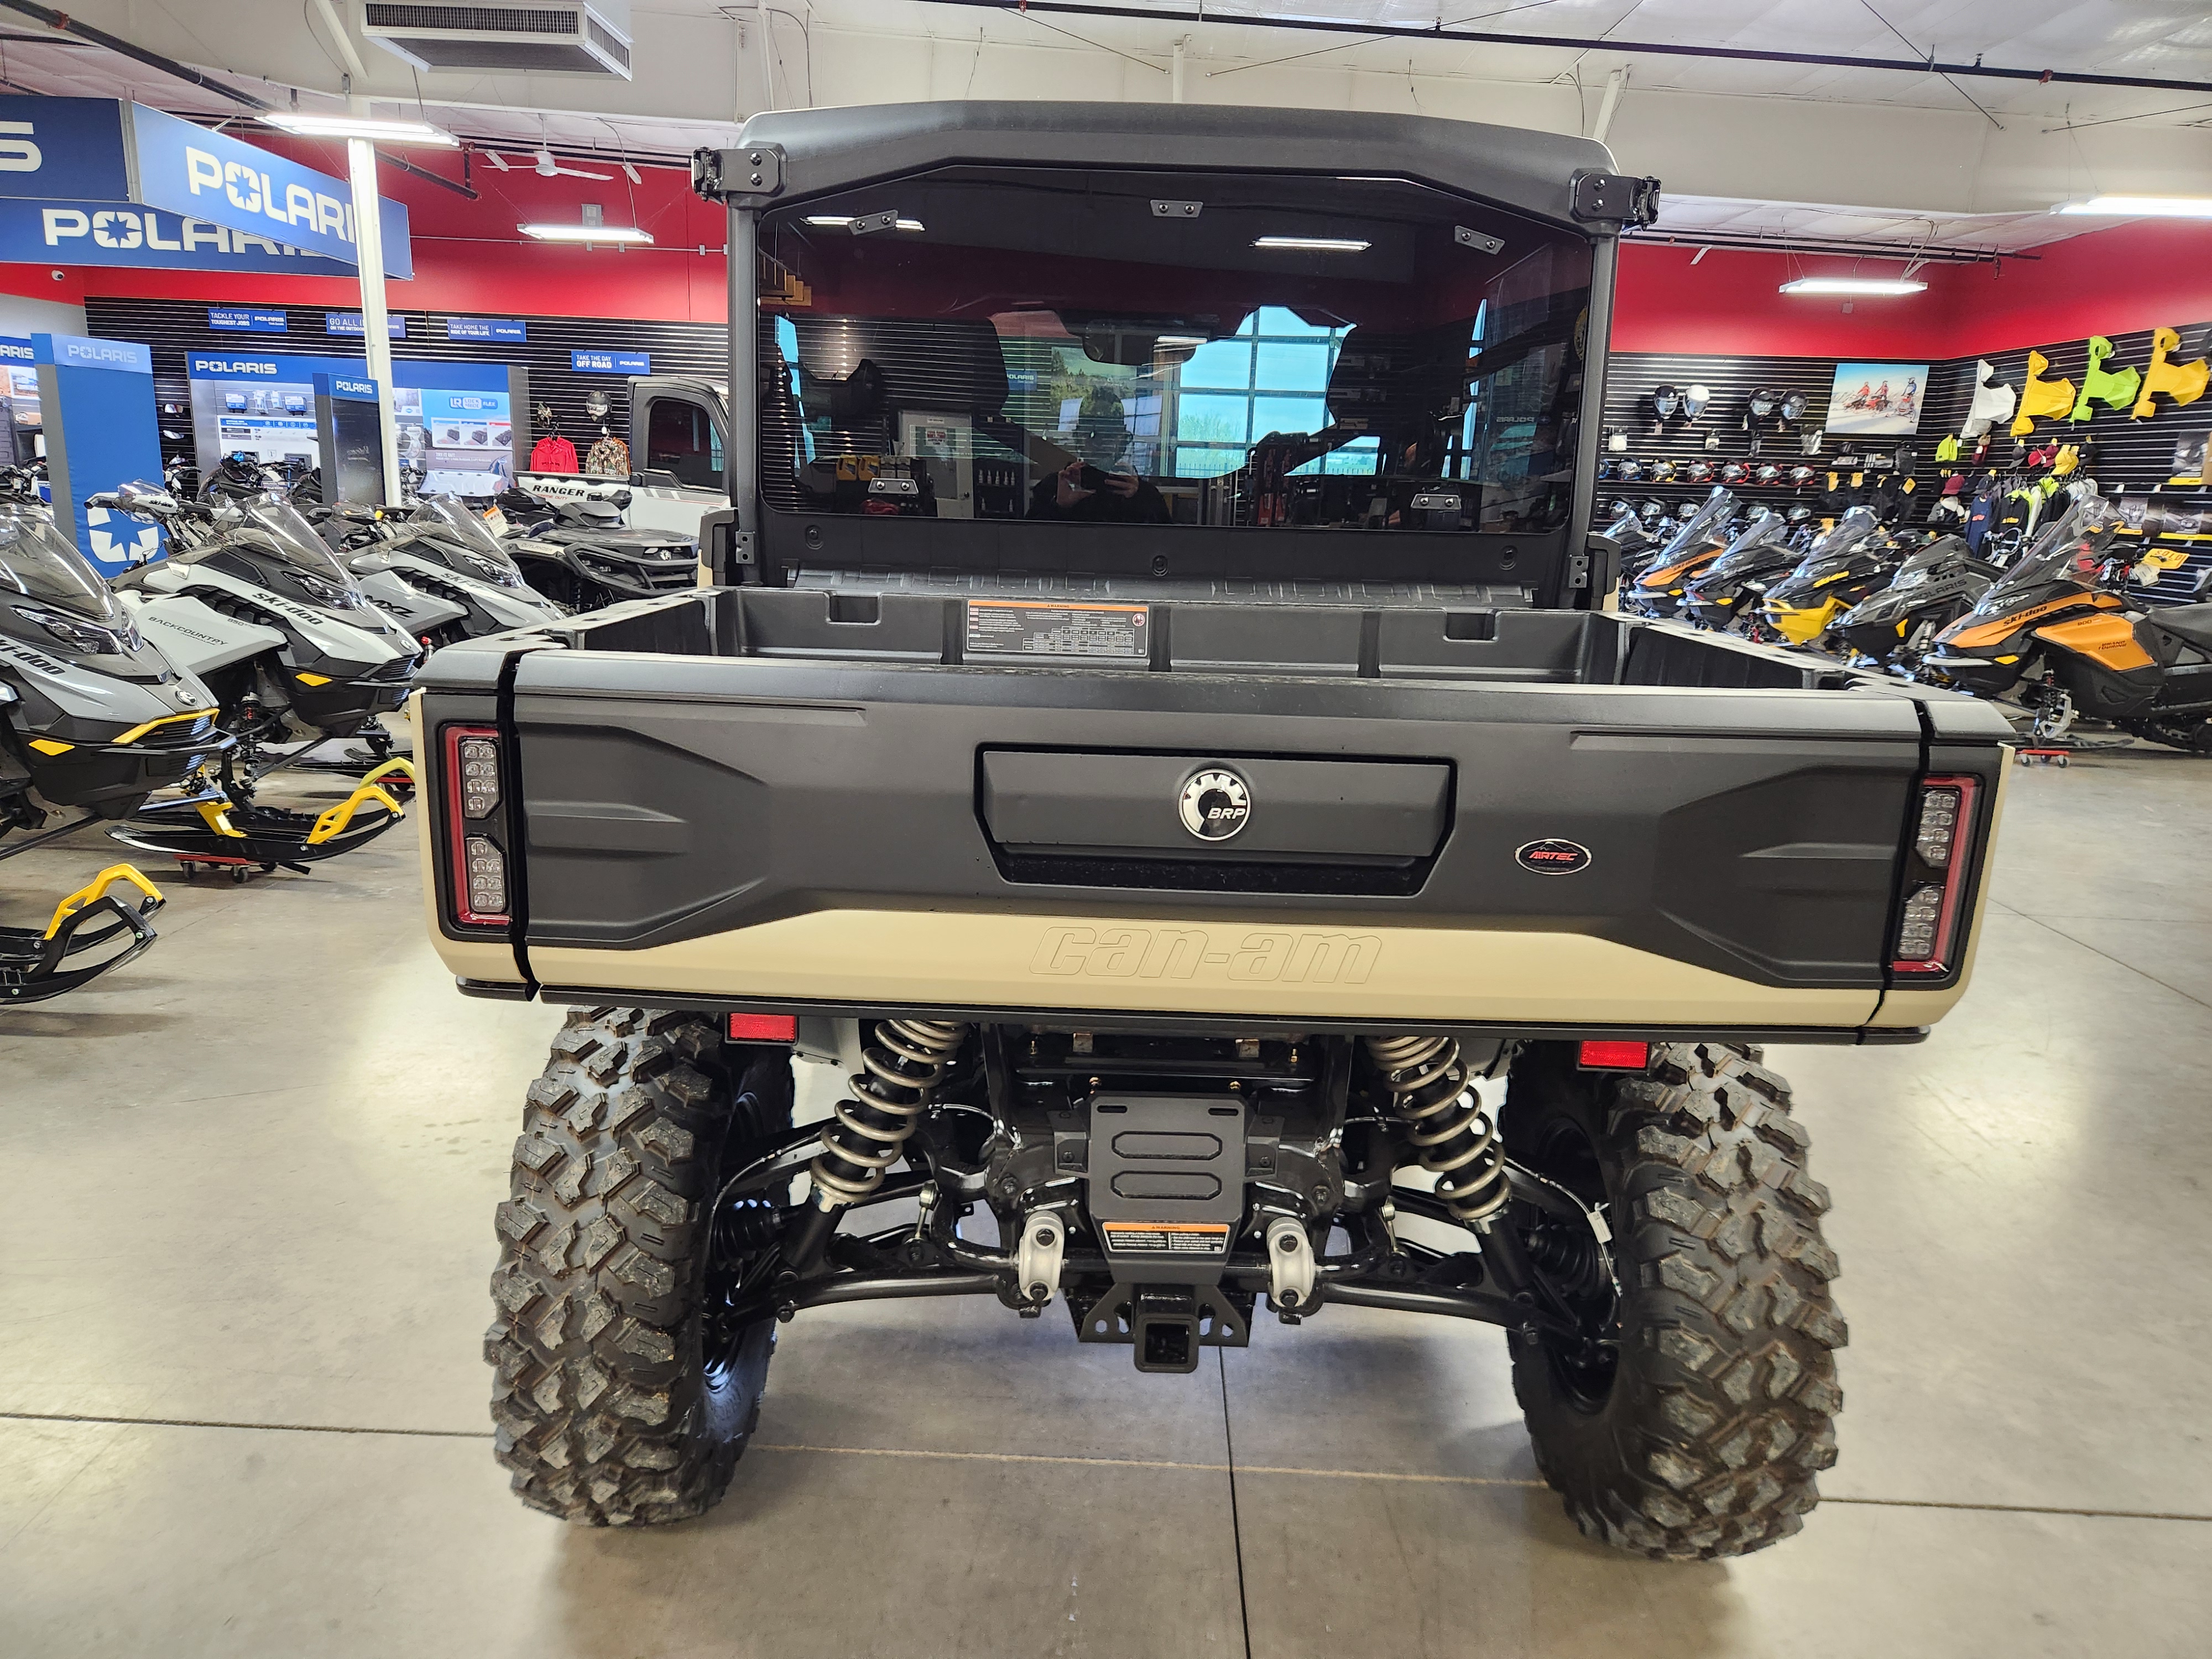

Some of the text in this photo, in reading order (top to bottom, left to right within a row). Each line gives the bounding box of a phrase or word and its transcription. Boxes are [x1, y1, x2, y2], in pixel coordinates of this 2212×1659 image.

[186, 146, 356, 243] POLARI
[42, 208, 324, 257] POLAR
[0, 345, 34, 359] ARIS
[67, 345, 137, 363] POLARIS
[195, 360, 276, 374] POLARIS
[336, 380, 373, 394] POLARIS
[533, 485, 585, 497] RANGER
[521, 543, 552, 552] OUTLANDER
[252, 593, 324, 625] ski-doo
[2003, 606, 2048, 627] ski-doo
[148, 617, 229, 646] BACKCOUNTRY
[1207, 807, 1246, 819] BRP
[1029, 926, 1382, 984] can-am
